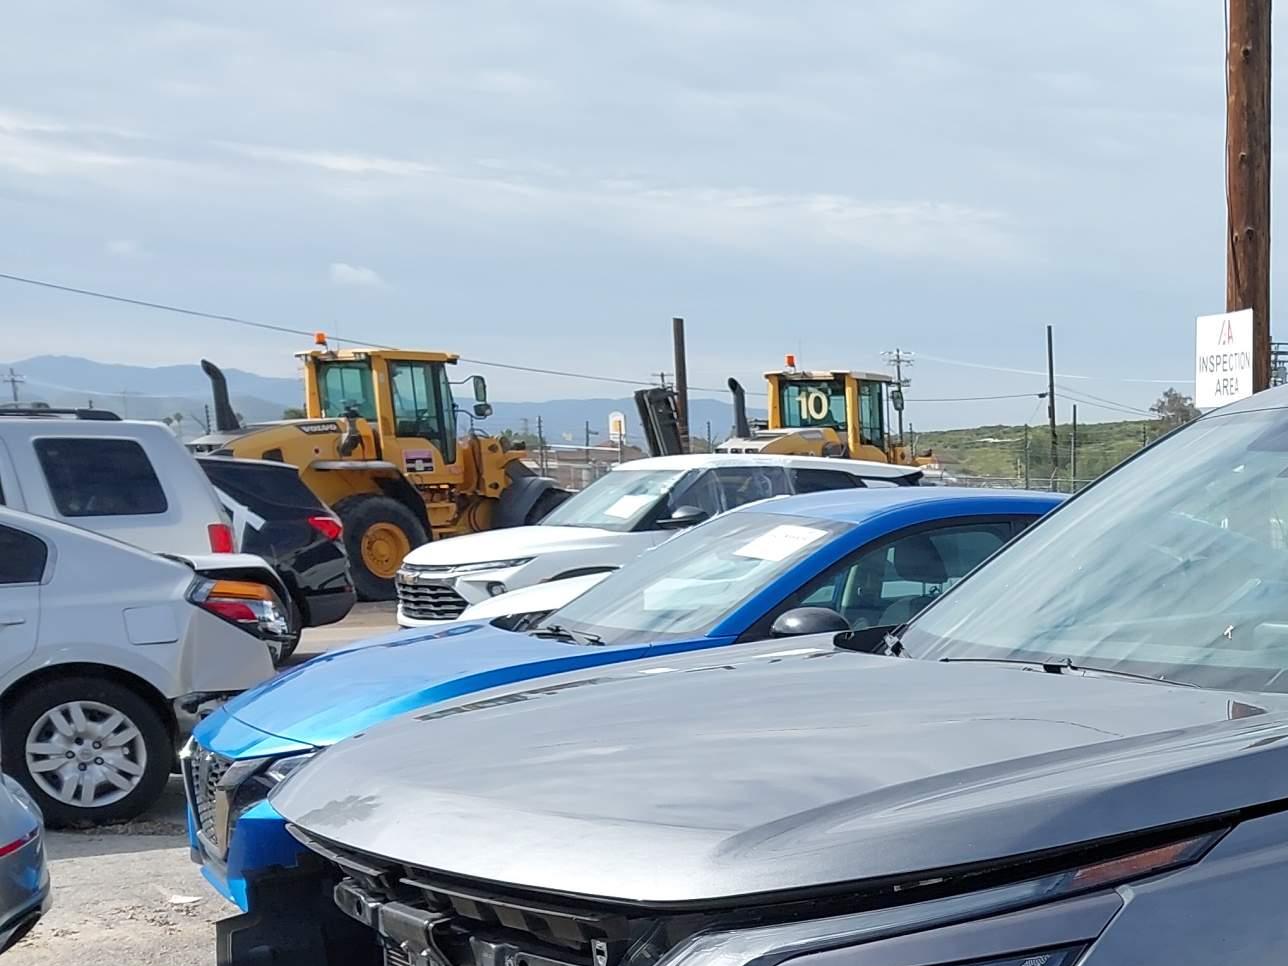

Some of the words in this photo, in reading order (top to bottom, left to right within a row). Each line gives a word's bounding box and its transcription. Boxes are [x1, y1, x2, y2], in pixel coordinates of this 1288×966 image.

[1198, 352, 1250, 373] INSPECTION
[1214, 377, 1239, 396] AREA
[795, 391, 829, 420] 10
